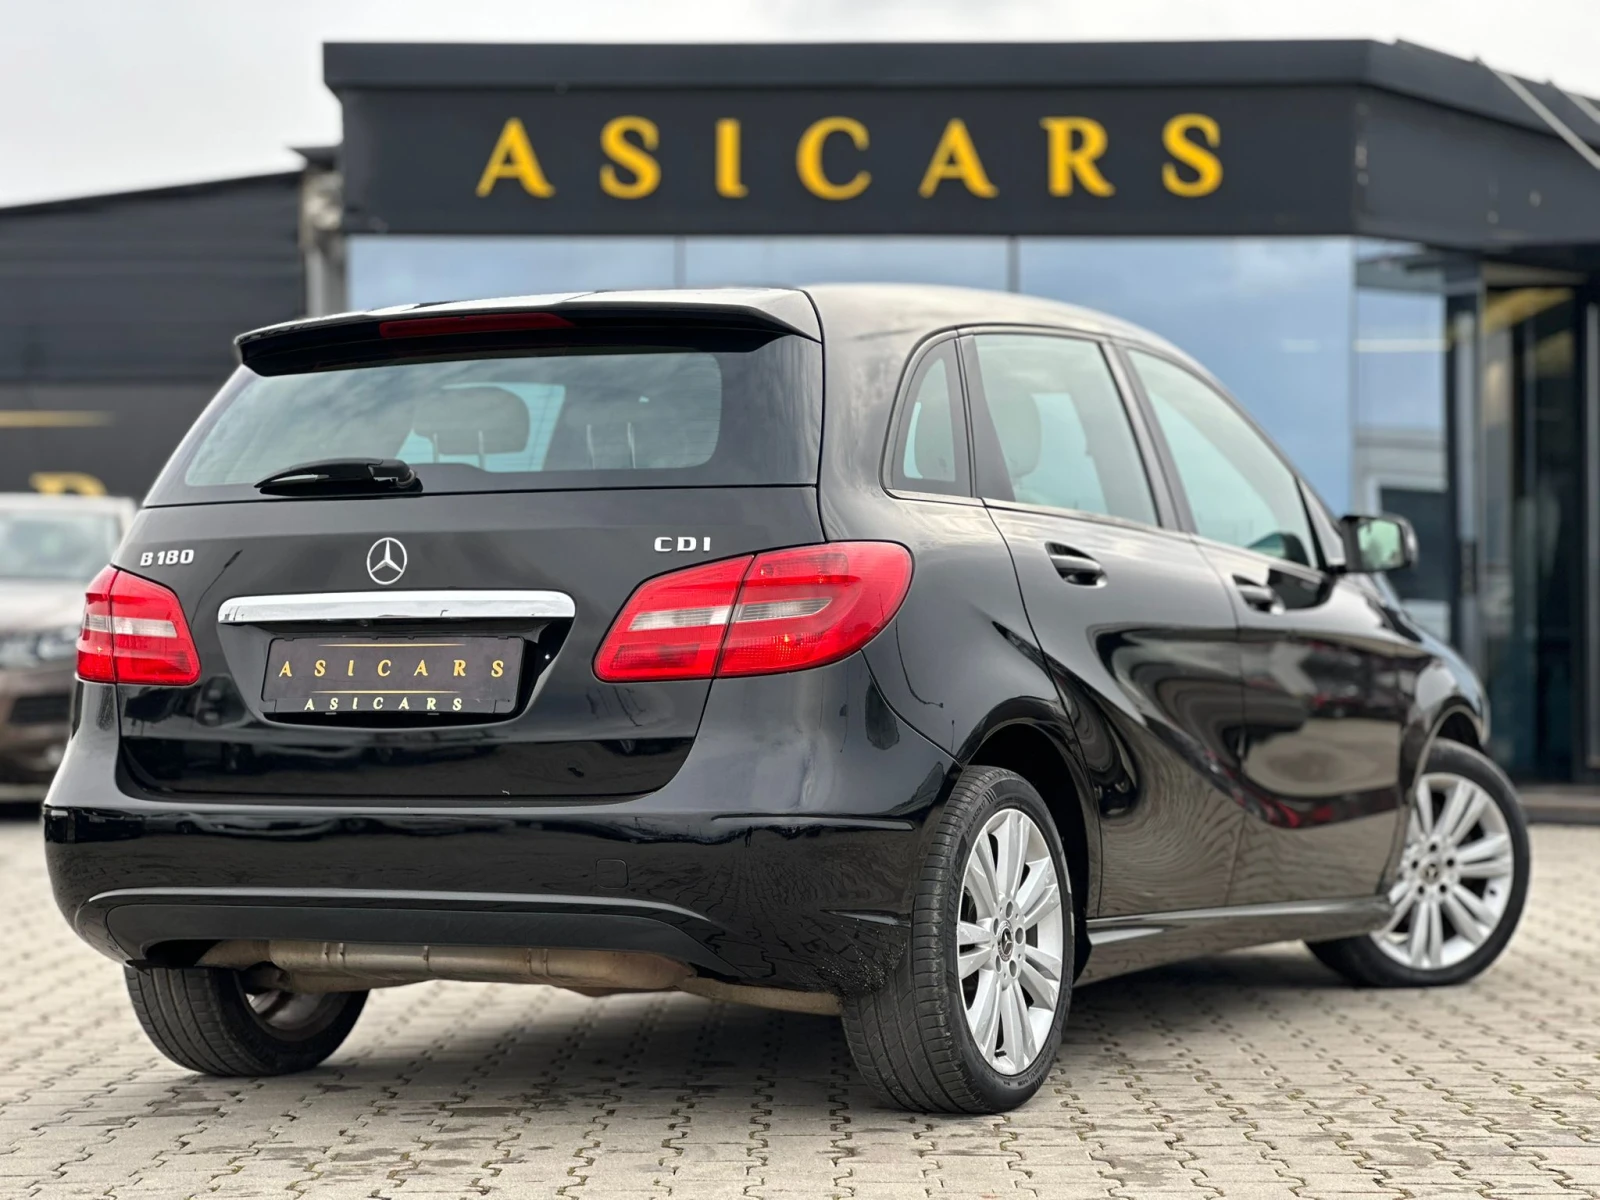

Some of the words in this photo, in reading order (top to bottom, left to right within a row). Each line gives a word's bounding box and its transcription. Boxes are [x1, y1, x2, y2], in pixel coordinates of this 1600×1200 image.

[475, 113, 1223, 200] ASICARS
[654, 536, 711, 552] CDI
[140, 552, 154, 567] B
[157, 549, 195, 566] 180
[279, 659, 504, 678] ASICARS
[304, 697, 463, 712] ASICARS
